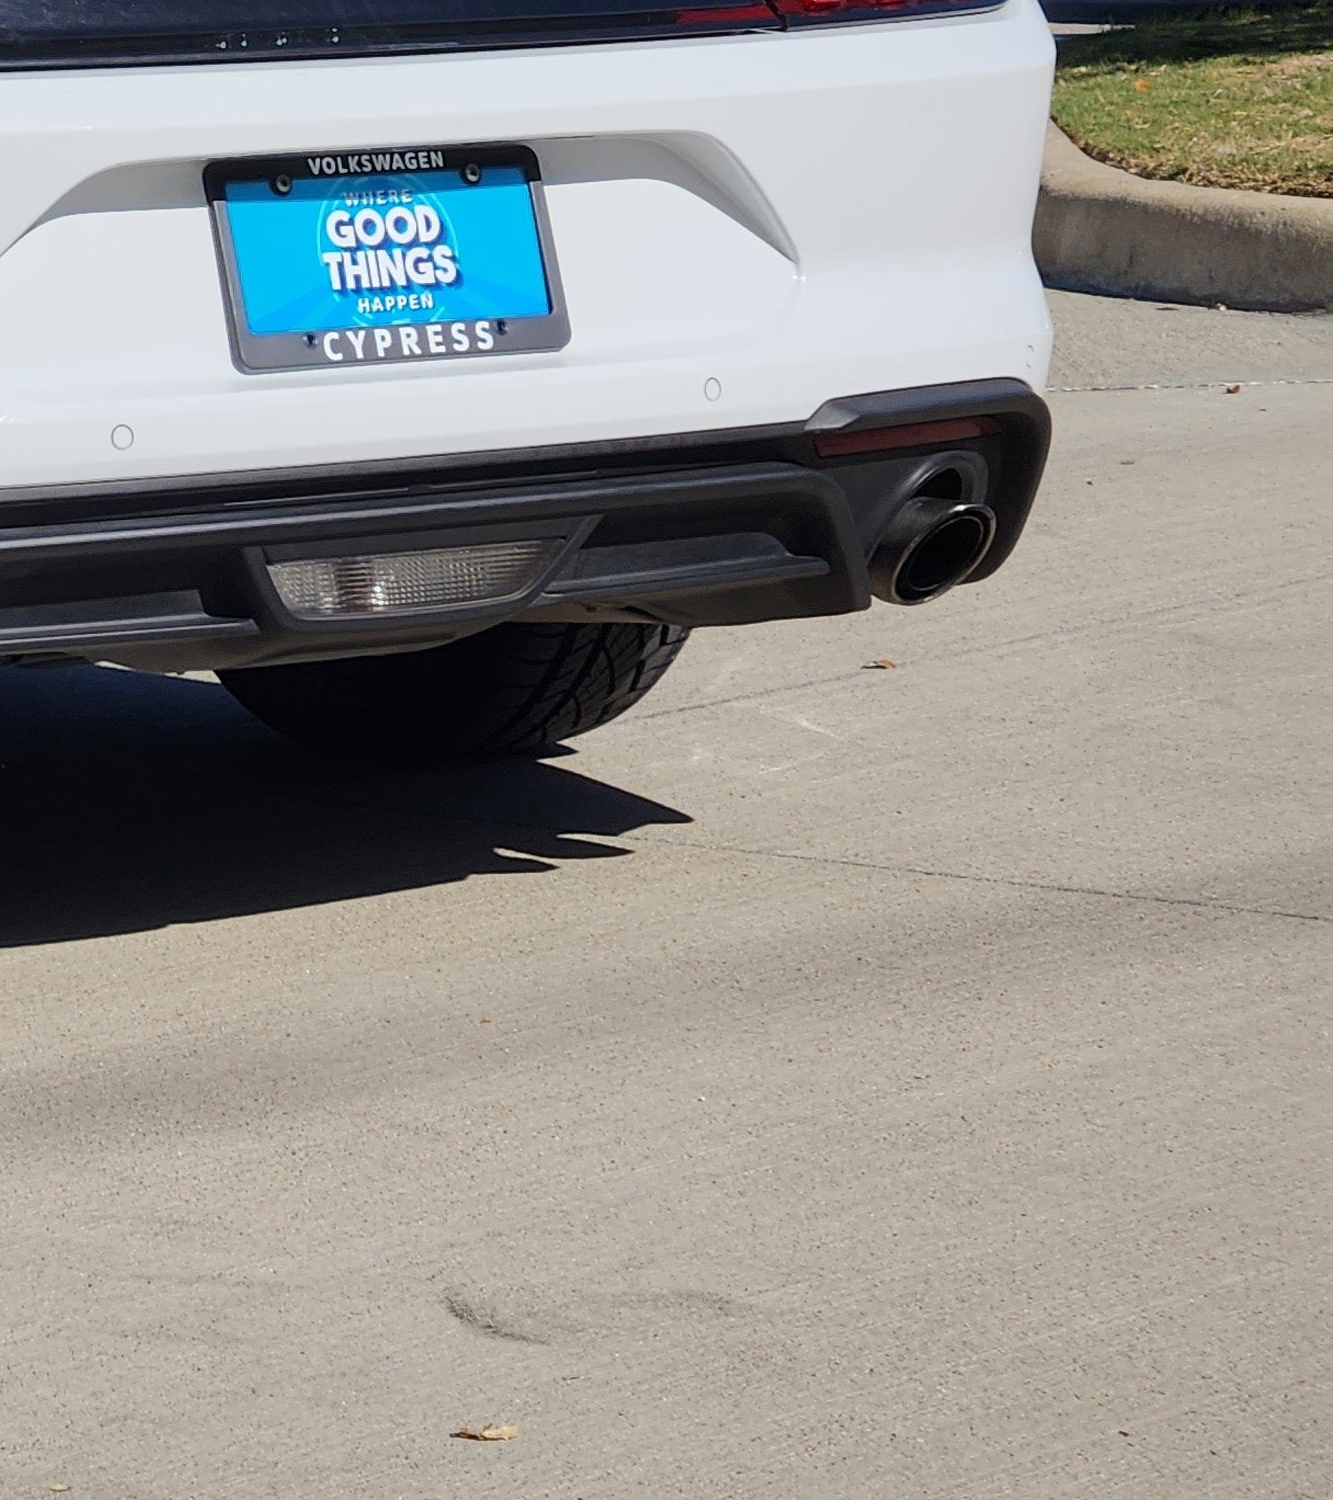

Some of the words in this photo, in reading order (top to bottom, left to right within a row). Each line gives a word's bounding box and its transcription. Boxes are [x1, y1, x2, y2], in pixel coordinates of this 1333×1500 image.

[308, 151, 444, 175] VOLKSWAGEN
[343, 188, 414, 206] WHERE
[326, 205, 440, 248] GOOD
[323, 244, 458, 290] THINGS
[358, 294, 434, 313] HAPPEN
[323, 322, 494, 361] CYPRESS
